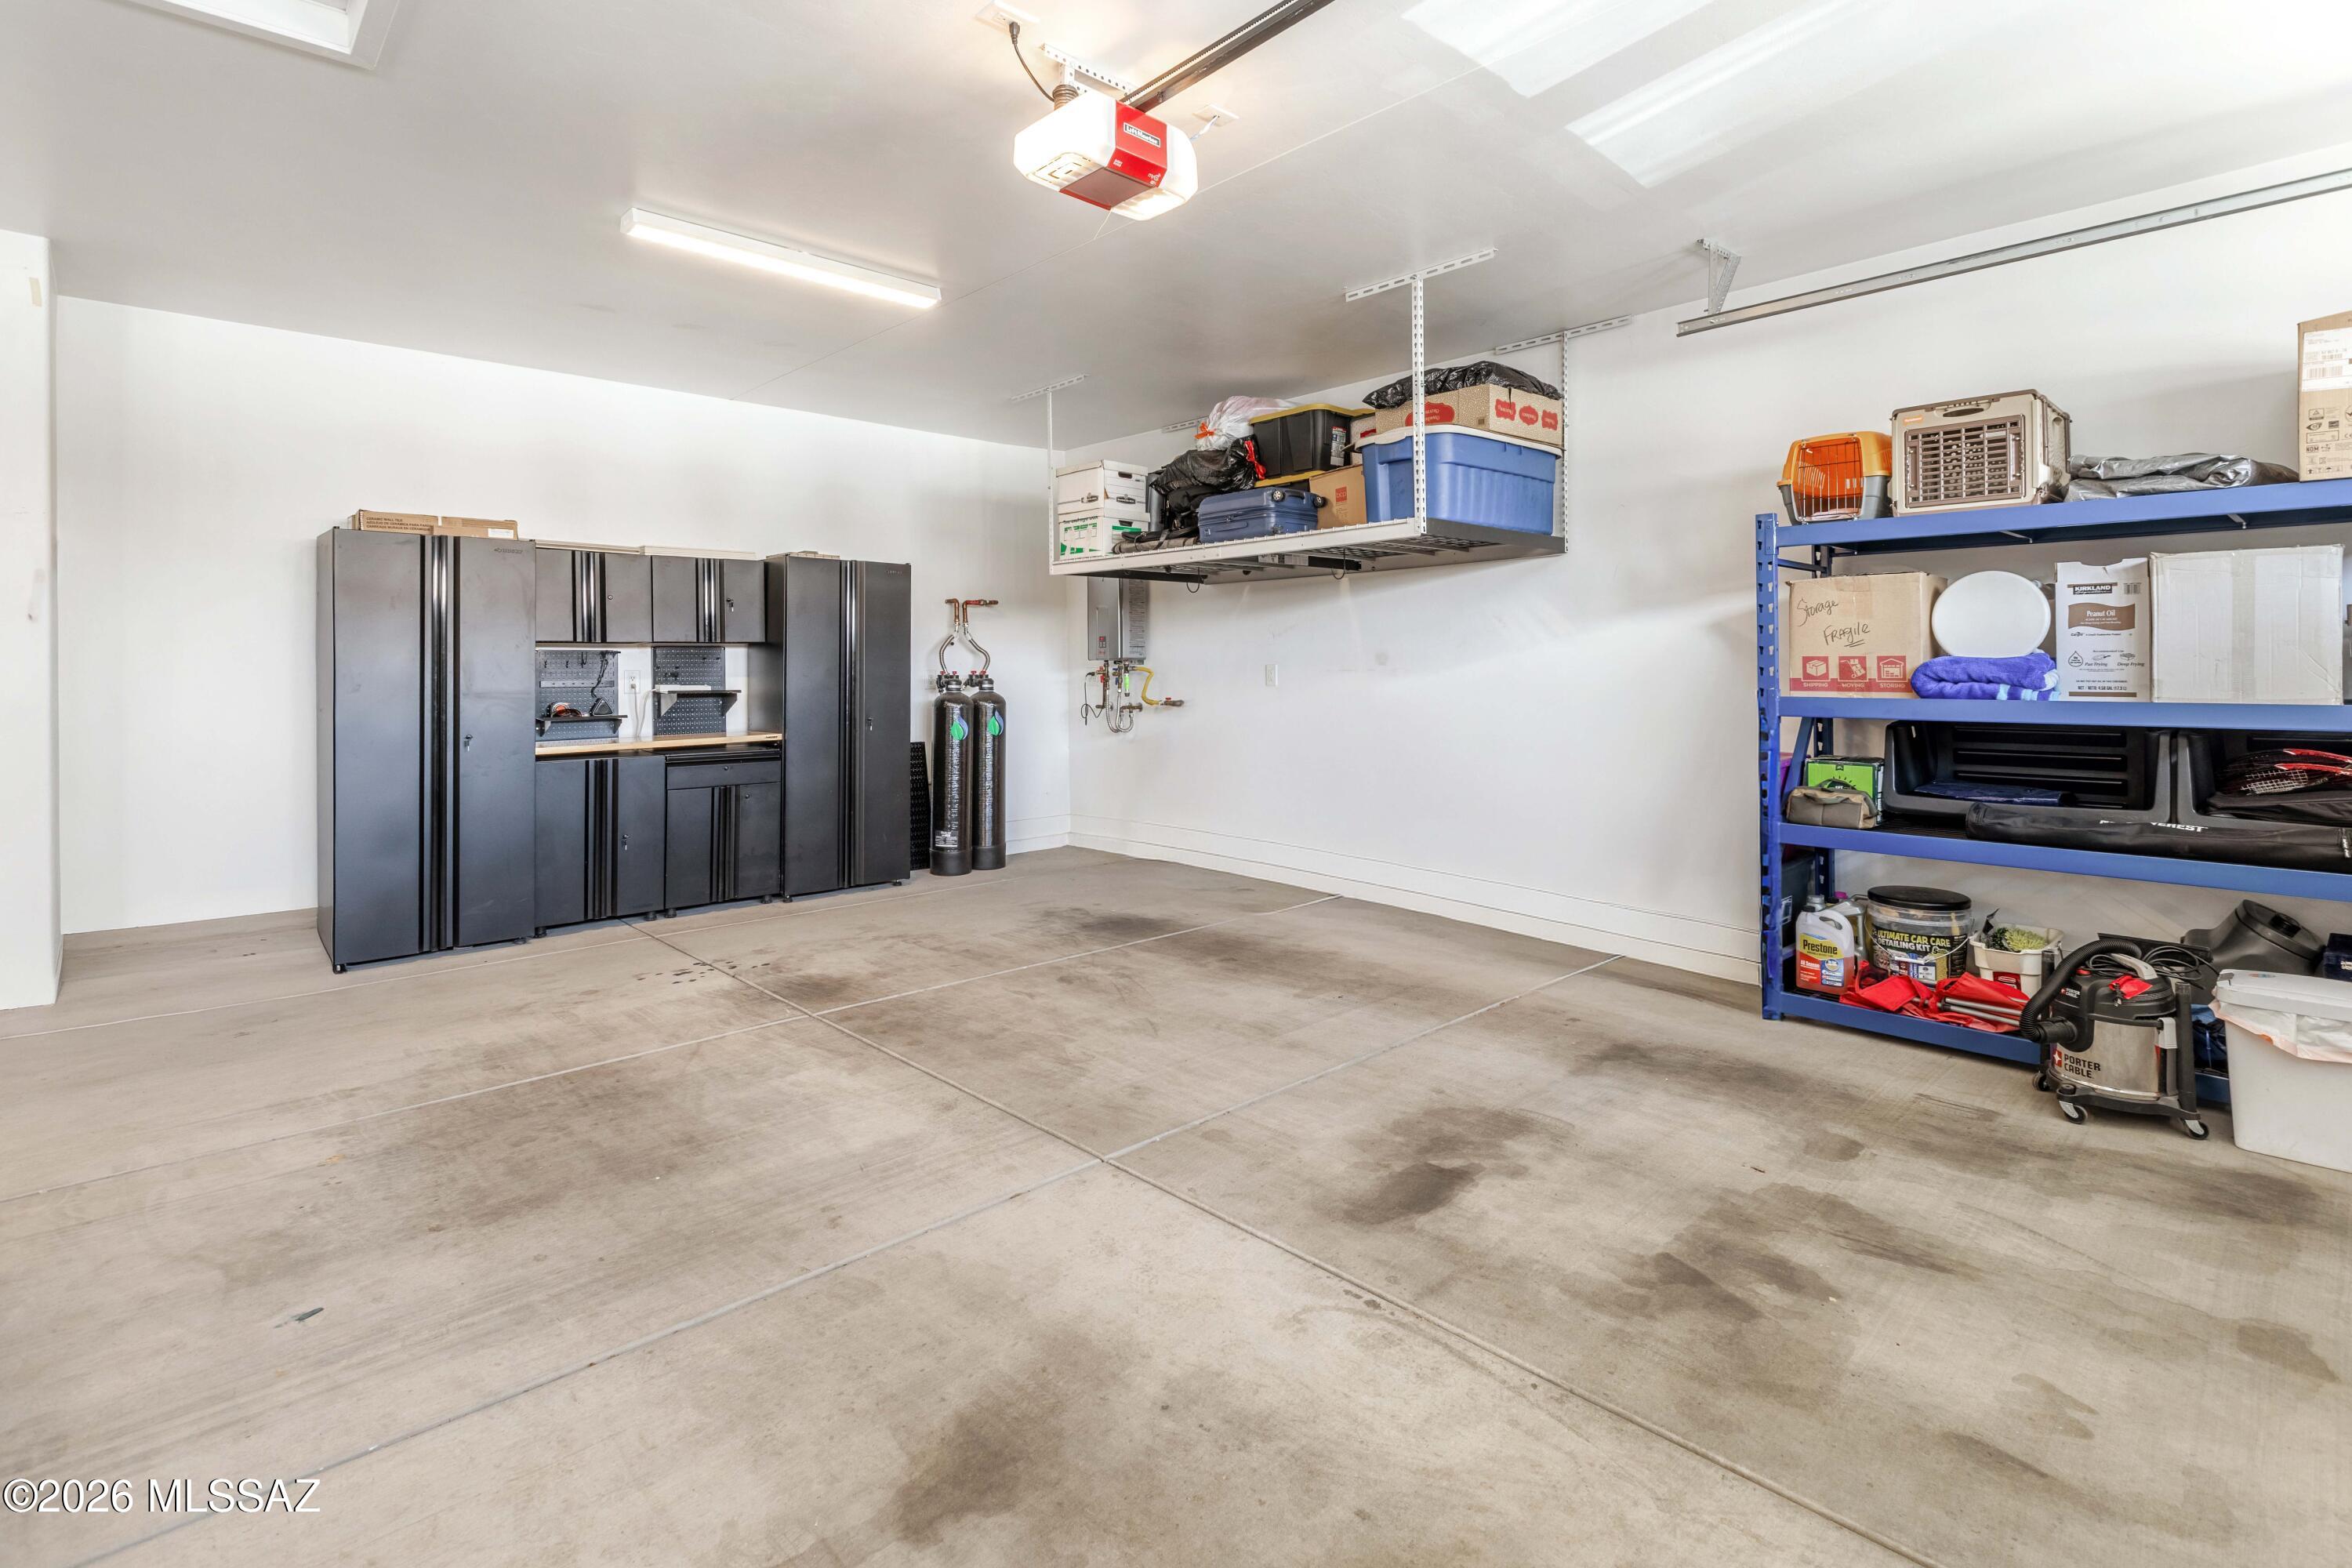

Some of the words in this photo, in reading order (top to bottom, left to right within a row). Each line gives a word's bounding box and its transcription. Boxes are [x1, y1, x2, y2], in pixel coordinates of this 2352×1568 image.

[1796, 597, 1838, 627] Storage
[1878, 930, 1910, 942] ULTIMATE
[1910, 935, 1929, 945] CAR
[1929, 937, 1951, 947] CARE
[1878, 938, 1915, 949] DETAILING
[1916, 943, 1931, 952] KIT
[1802, 939, 1838, 955] Prestone
[2064, 1054, 2101, 1071] PORTER
[2064, 1063, 2092, 1078] CABLE
